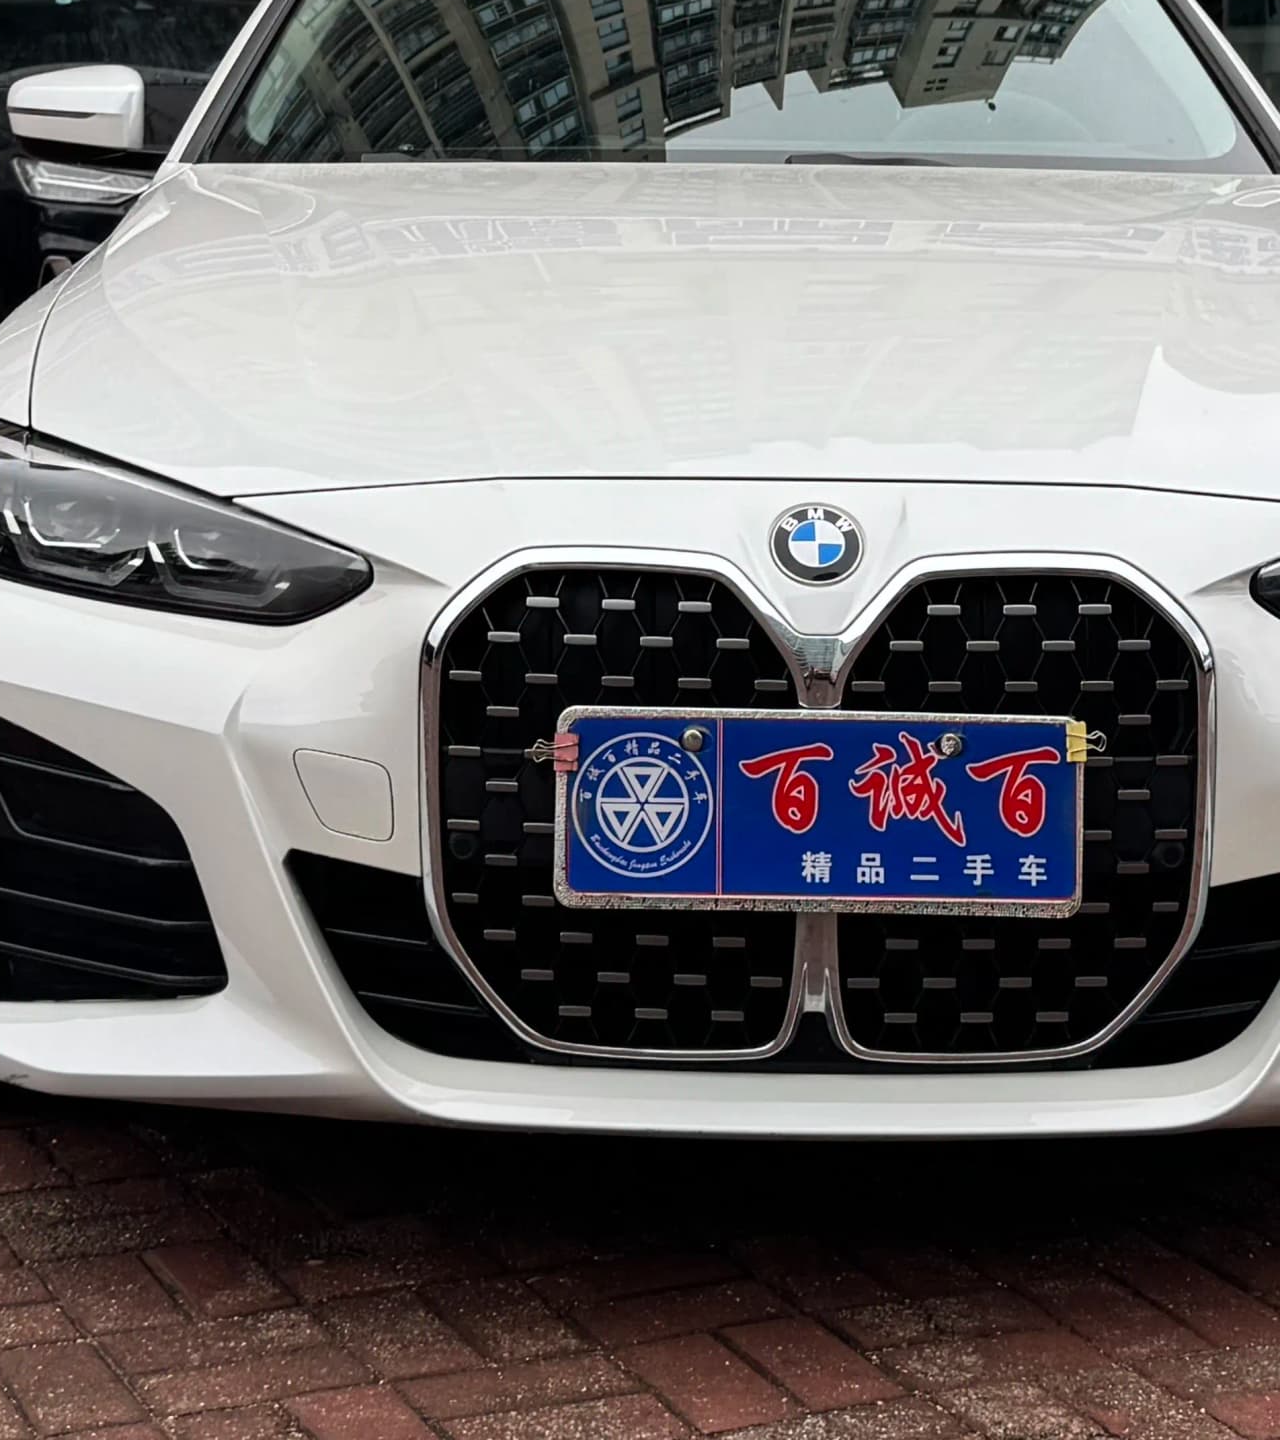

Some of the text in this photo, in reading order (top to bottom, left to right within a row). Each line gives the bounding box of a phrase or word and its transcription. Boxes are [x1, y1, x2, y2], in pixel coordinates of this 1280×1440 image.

[780, 507, 855, 533] BMW
[800, 850, 1049, 888] 精品二手车
